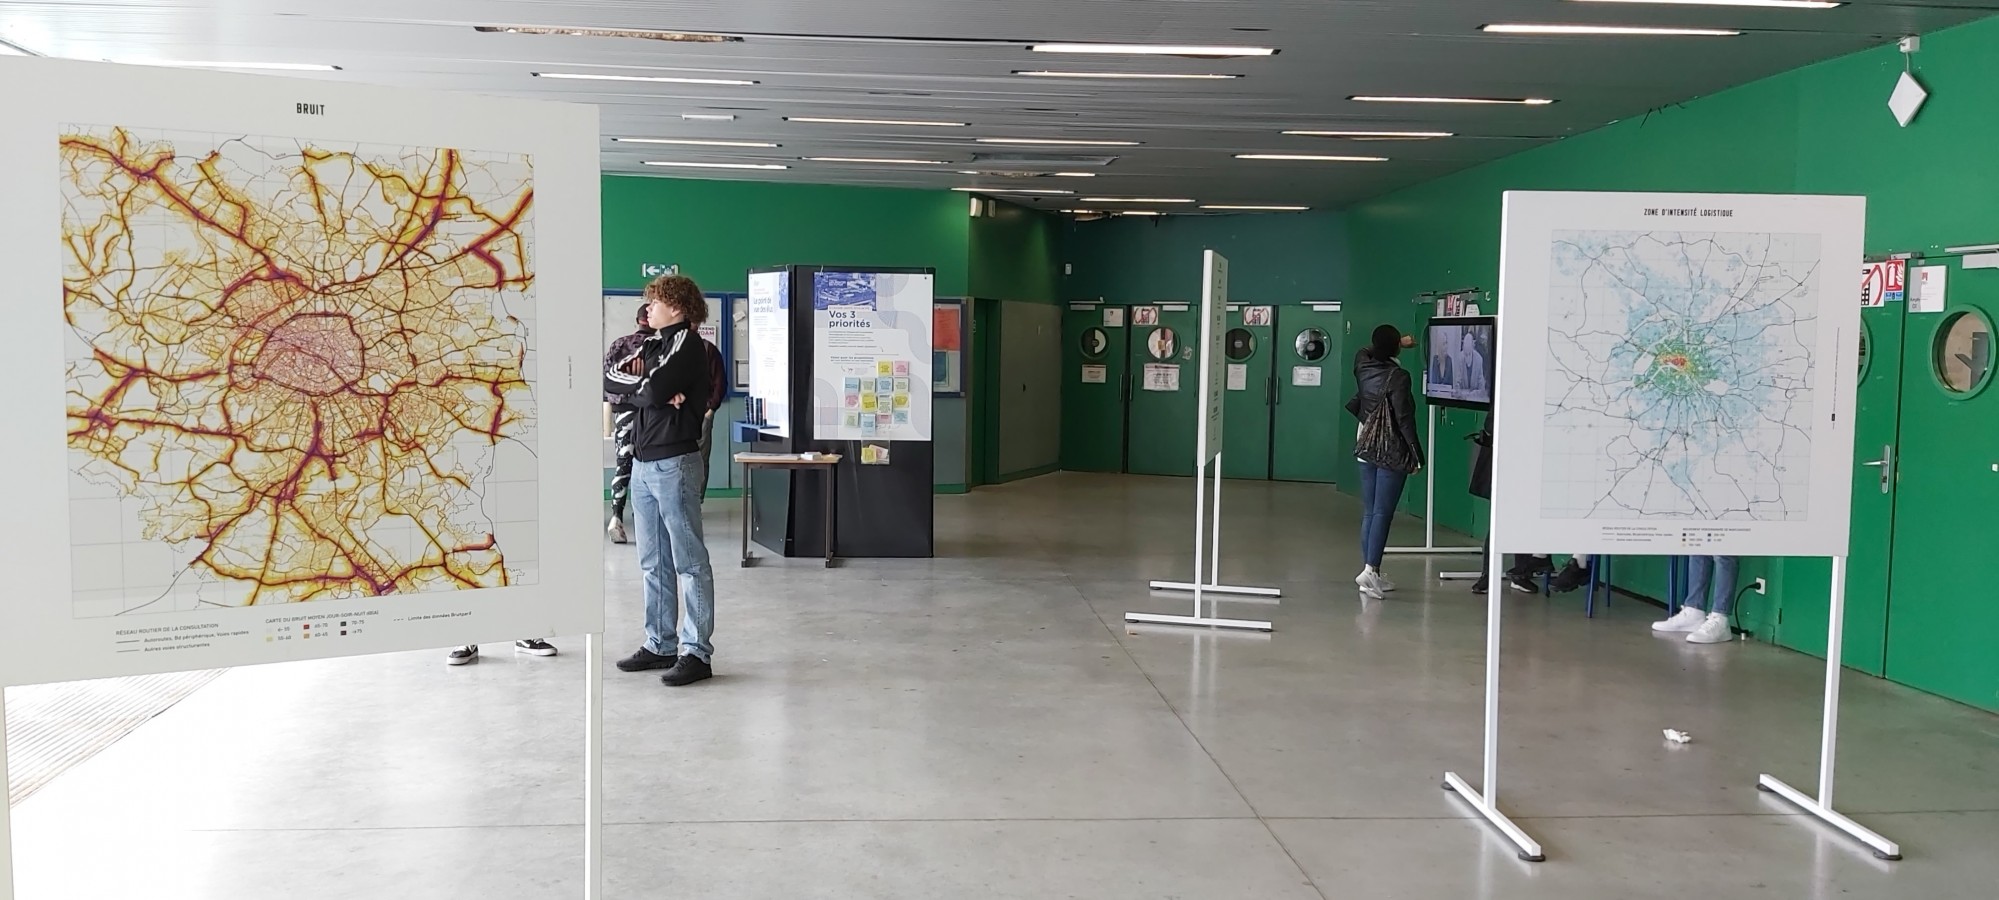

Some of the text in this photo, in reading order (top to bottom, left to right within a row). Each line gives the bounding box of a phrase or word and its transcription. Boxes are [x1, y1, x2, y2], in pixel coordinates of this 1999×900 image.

[296, 102, 325, 116] BRUIT
[1644, 207, 1733, 217] ZONE D'INTENSITÉ LOGISTIQUE
[829, 310, 856, 319] Vos 3
[829, 319, 871, 329] priorités
[179, 623, 219, 631] CONSULTATION
